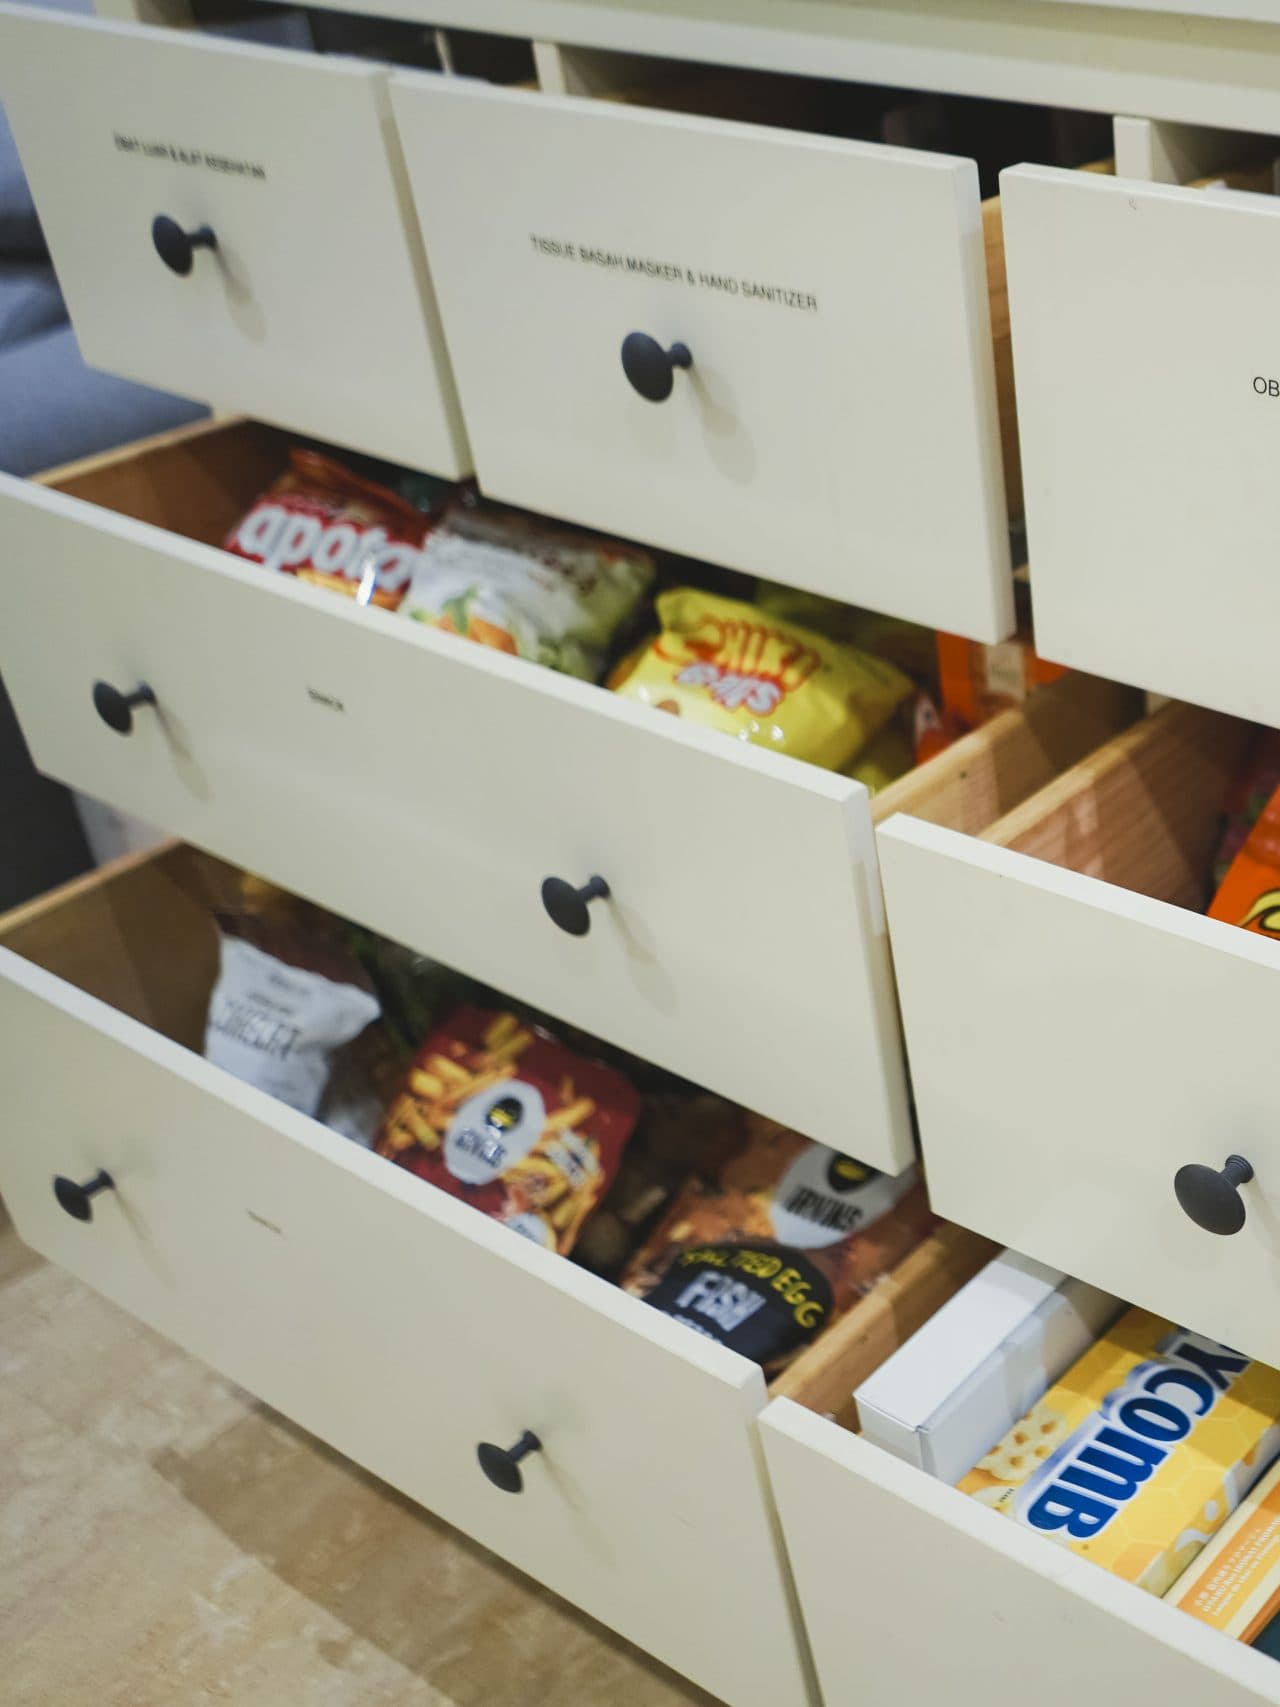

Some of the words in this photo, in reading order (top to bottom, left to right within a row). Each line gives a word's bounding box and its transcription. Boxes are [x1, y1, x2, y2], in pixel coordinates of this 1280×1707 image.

[529, 233, 576, 259] TISSUE
[625, 256, 683, 281] MASKER
[686, 267, 697, 286] &
[699, 271, 740, 294] HAND
[742, 279, 818, 312] SANITIZER
[1025, 1341, 1252, 1540] YCOMB
